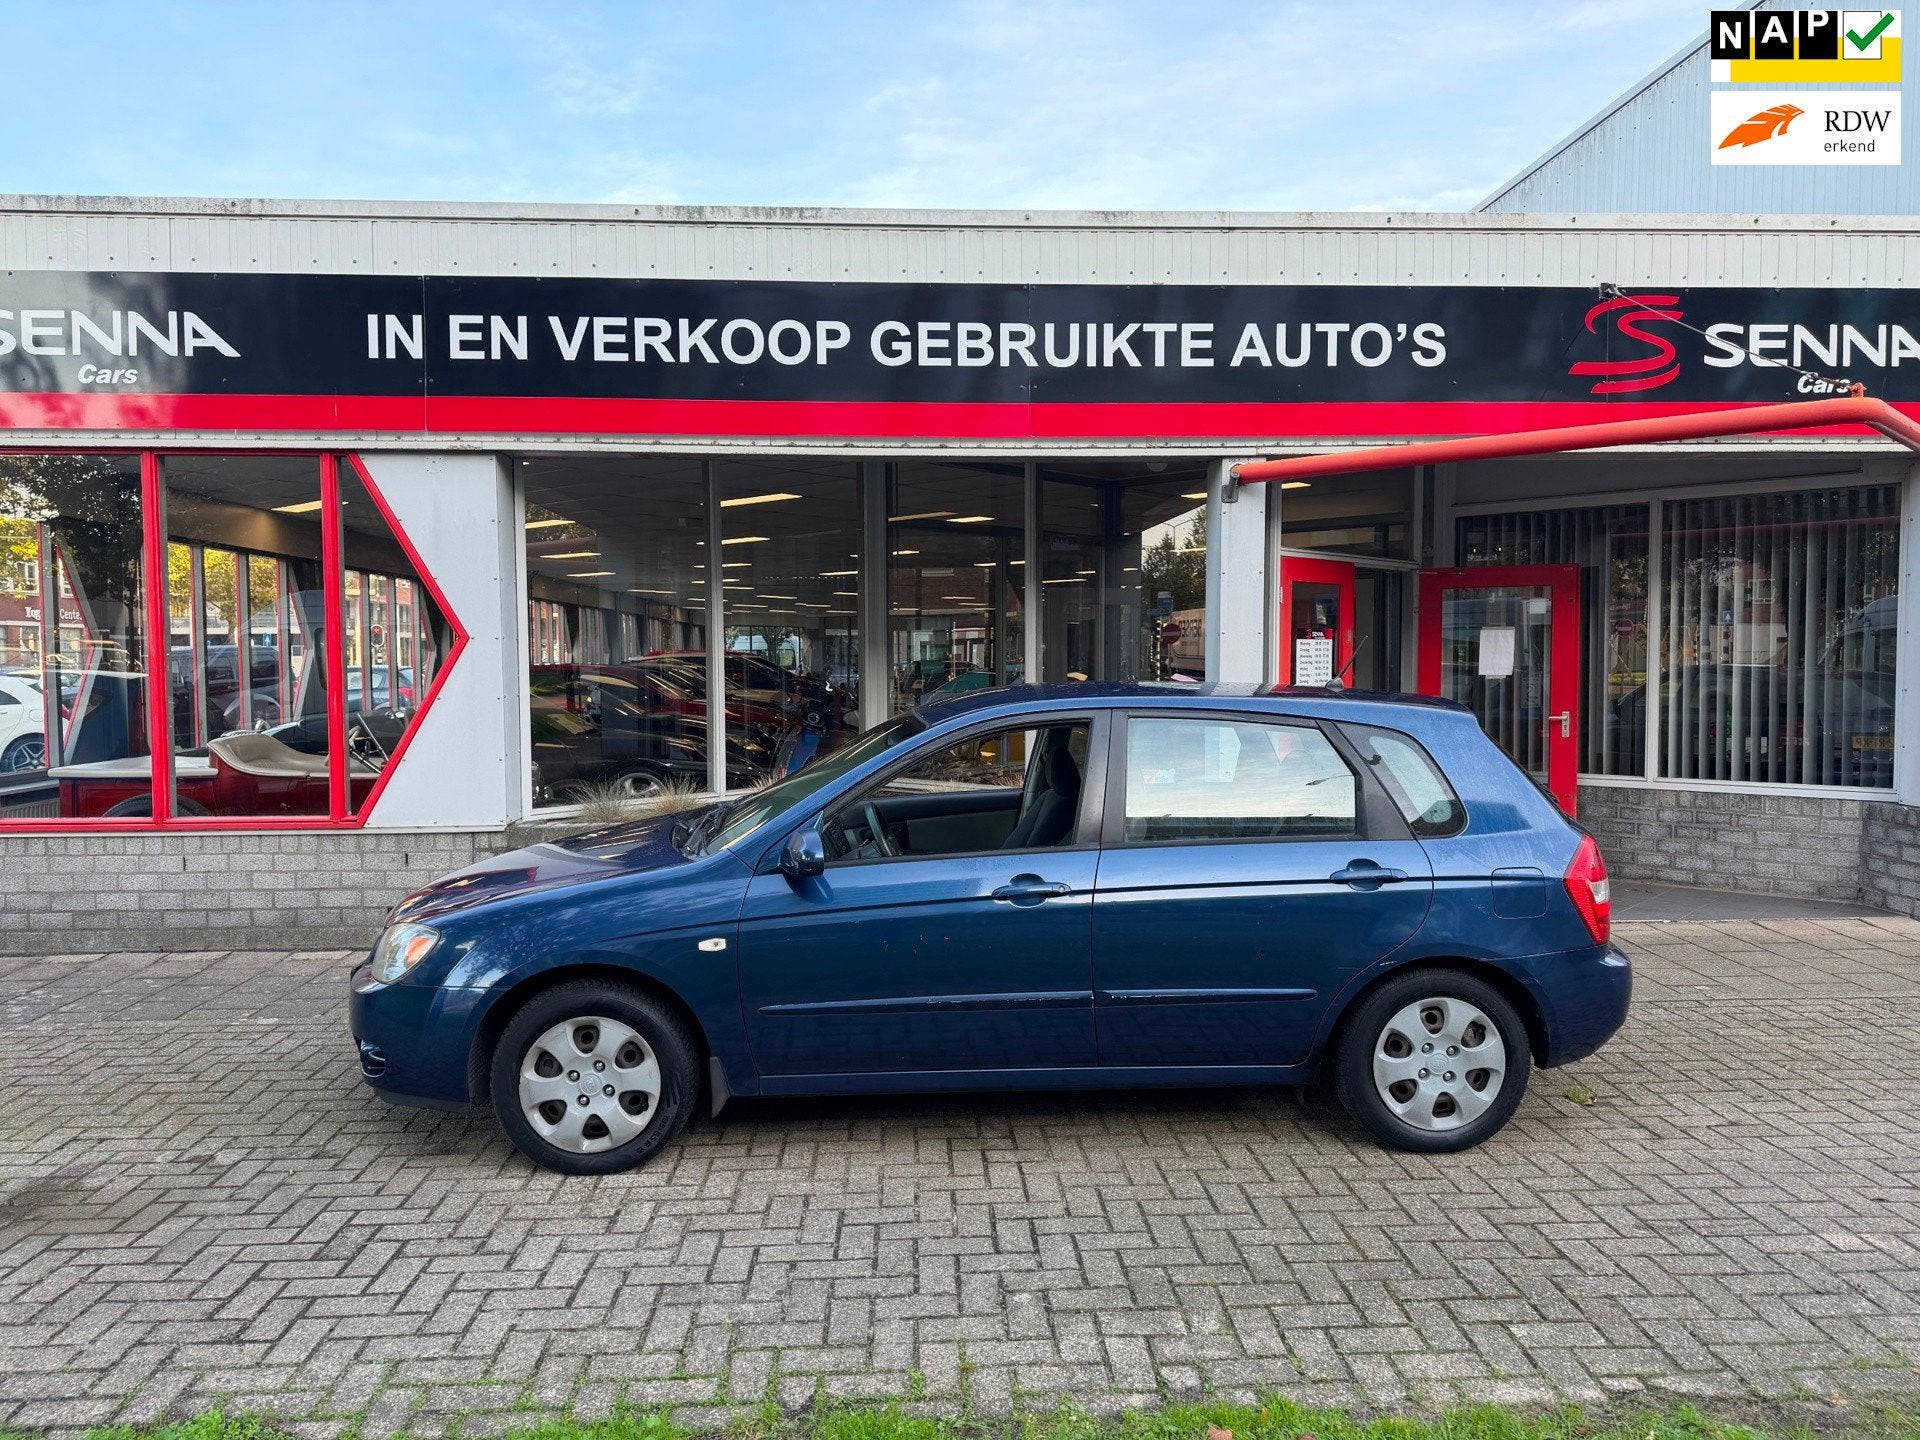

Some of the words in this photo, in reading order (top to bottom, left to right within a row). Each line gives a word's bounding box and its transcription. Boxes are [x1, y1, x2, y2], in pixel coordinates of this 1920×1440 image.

[367, 314, 423, 360] IN
[449, 314, 528, 360] EN
[548, 315, 851, 366] VERKOOP
[870, 320, 1215, 368] GEBRUIKTE
[1229, 322, 1446, 368] AUTO’S
[77, 363, 139, 385] Cars
[1797, 372, 1851, 394] Cars
[24, 606, 41, 620] Yog
[59, 608, 82, 620] Cente
